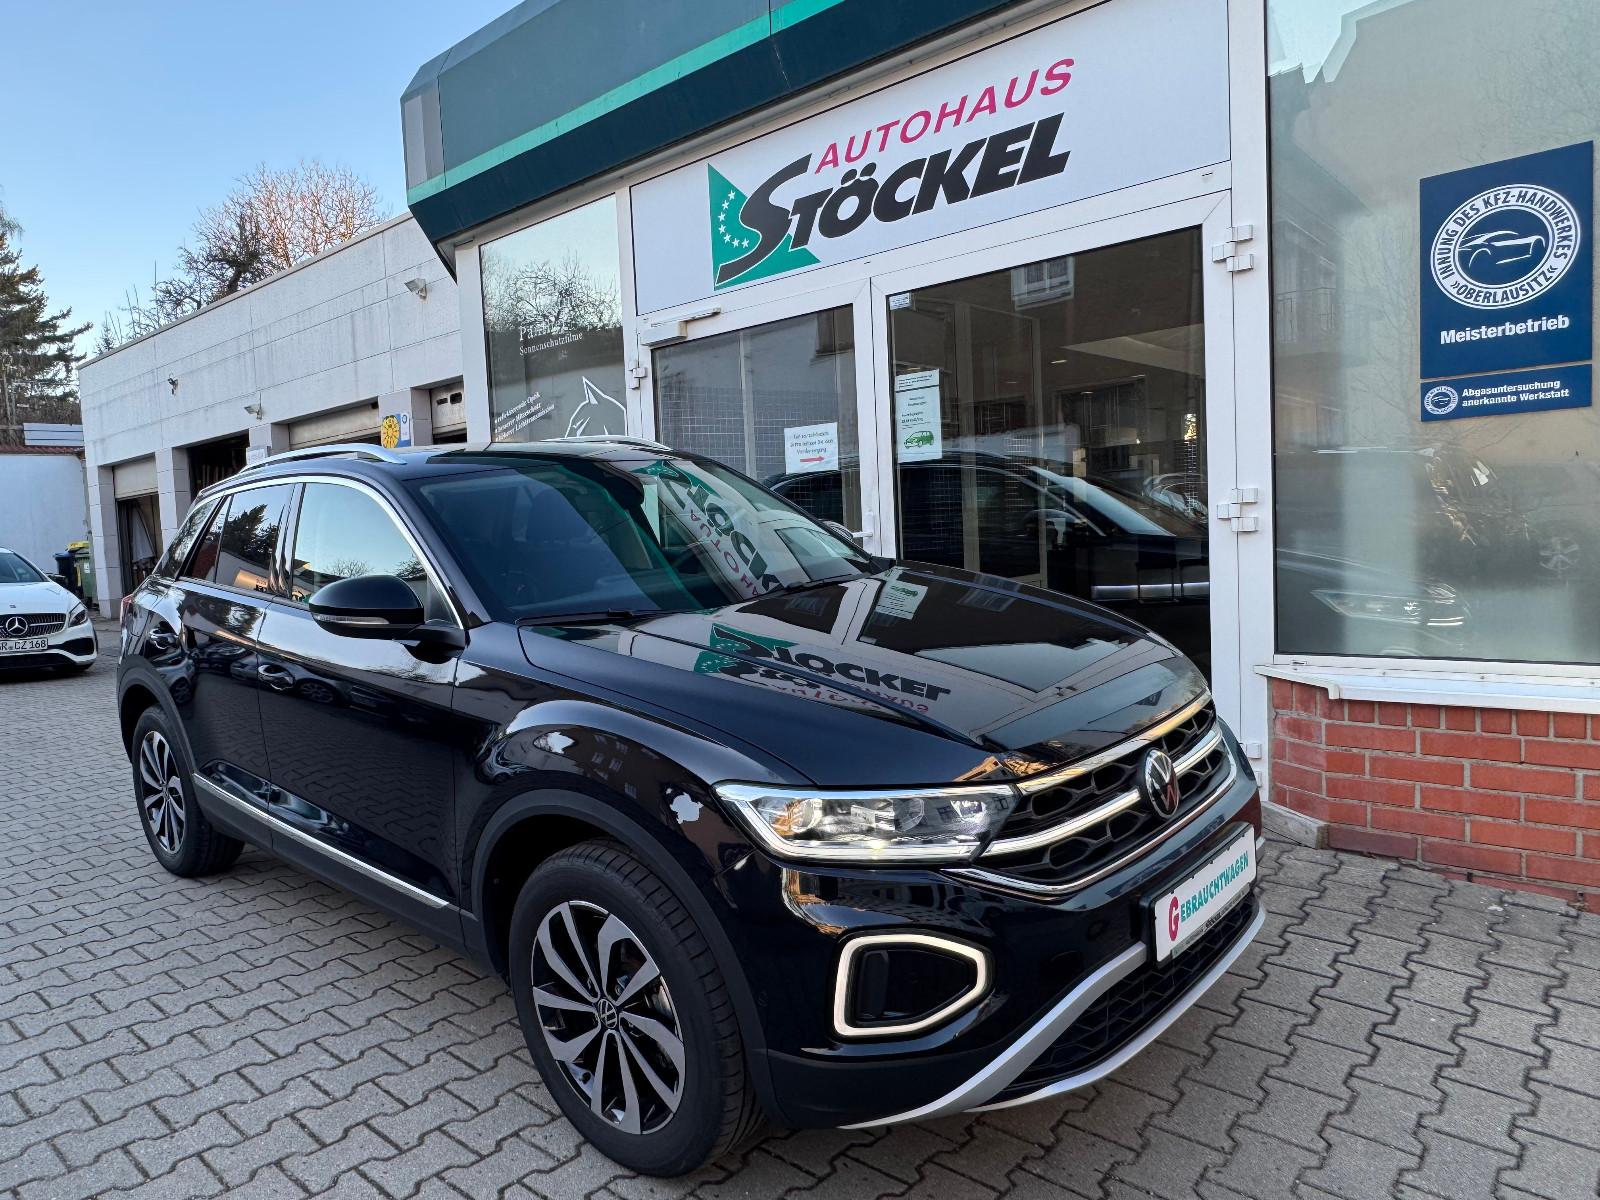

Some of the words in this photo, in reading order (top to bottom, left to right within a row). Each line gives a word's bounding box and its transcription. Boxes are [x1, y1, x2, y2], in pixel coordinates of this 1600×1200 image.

[815, 58, 1075, 175] AUTOHAUS
[715, 112, 1071, 286] STÖCKEL
[1437, 227, 1458, 281] INNUNG
[1454, 204, 1480, 229] DES
[1482, 189, 1572, 260] KFZ-HANDWERKES
[519, 332, 583, 356] Sonnenschutzfilme
[1440, 314, 1570, 345] Meisterbetrieb
[1462, 380, 1561, 397] Abgasuntersuchung
[1462, 393, 1517, 407] anerkannte
[1519, 389, 1570, 402] Werkstatt
[14, 641, 27, 650] CZ
[29, 639, 47, 649] 168
[1168, 851, 1249, 941] GEBRAUCHTWAGEN
